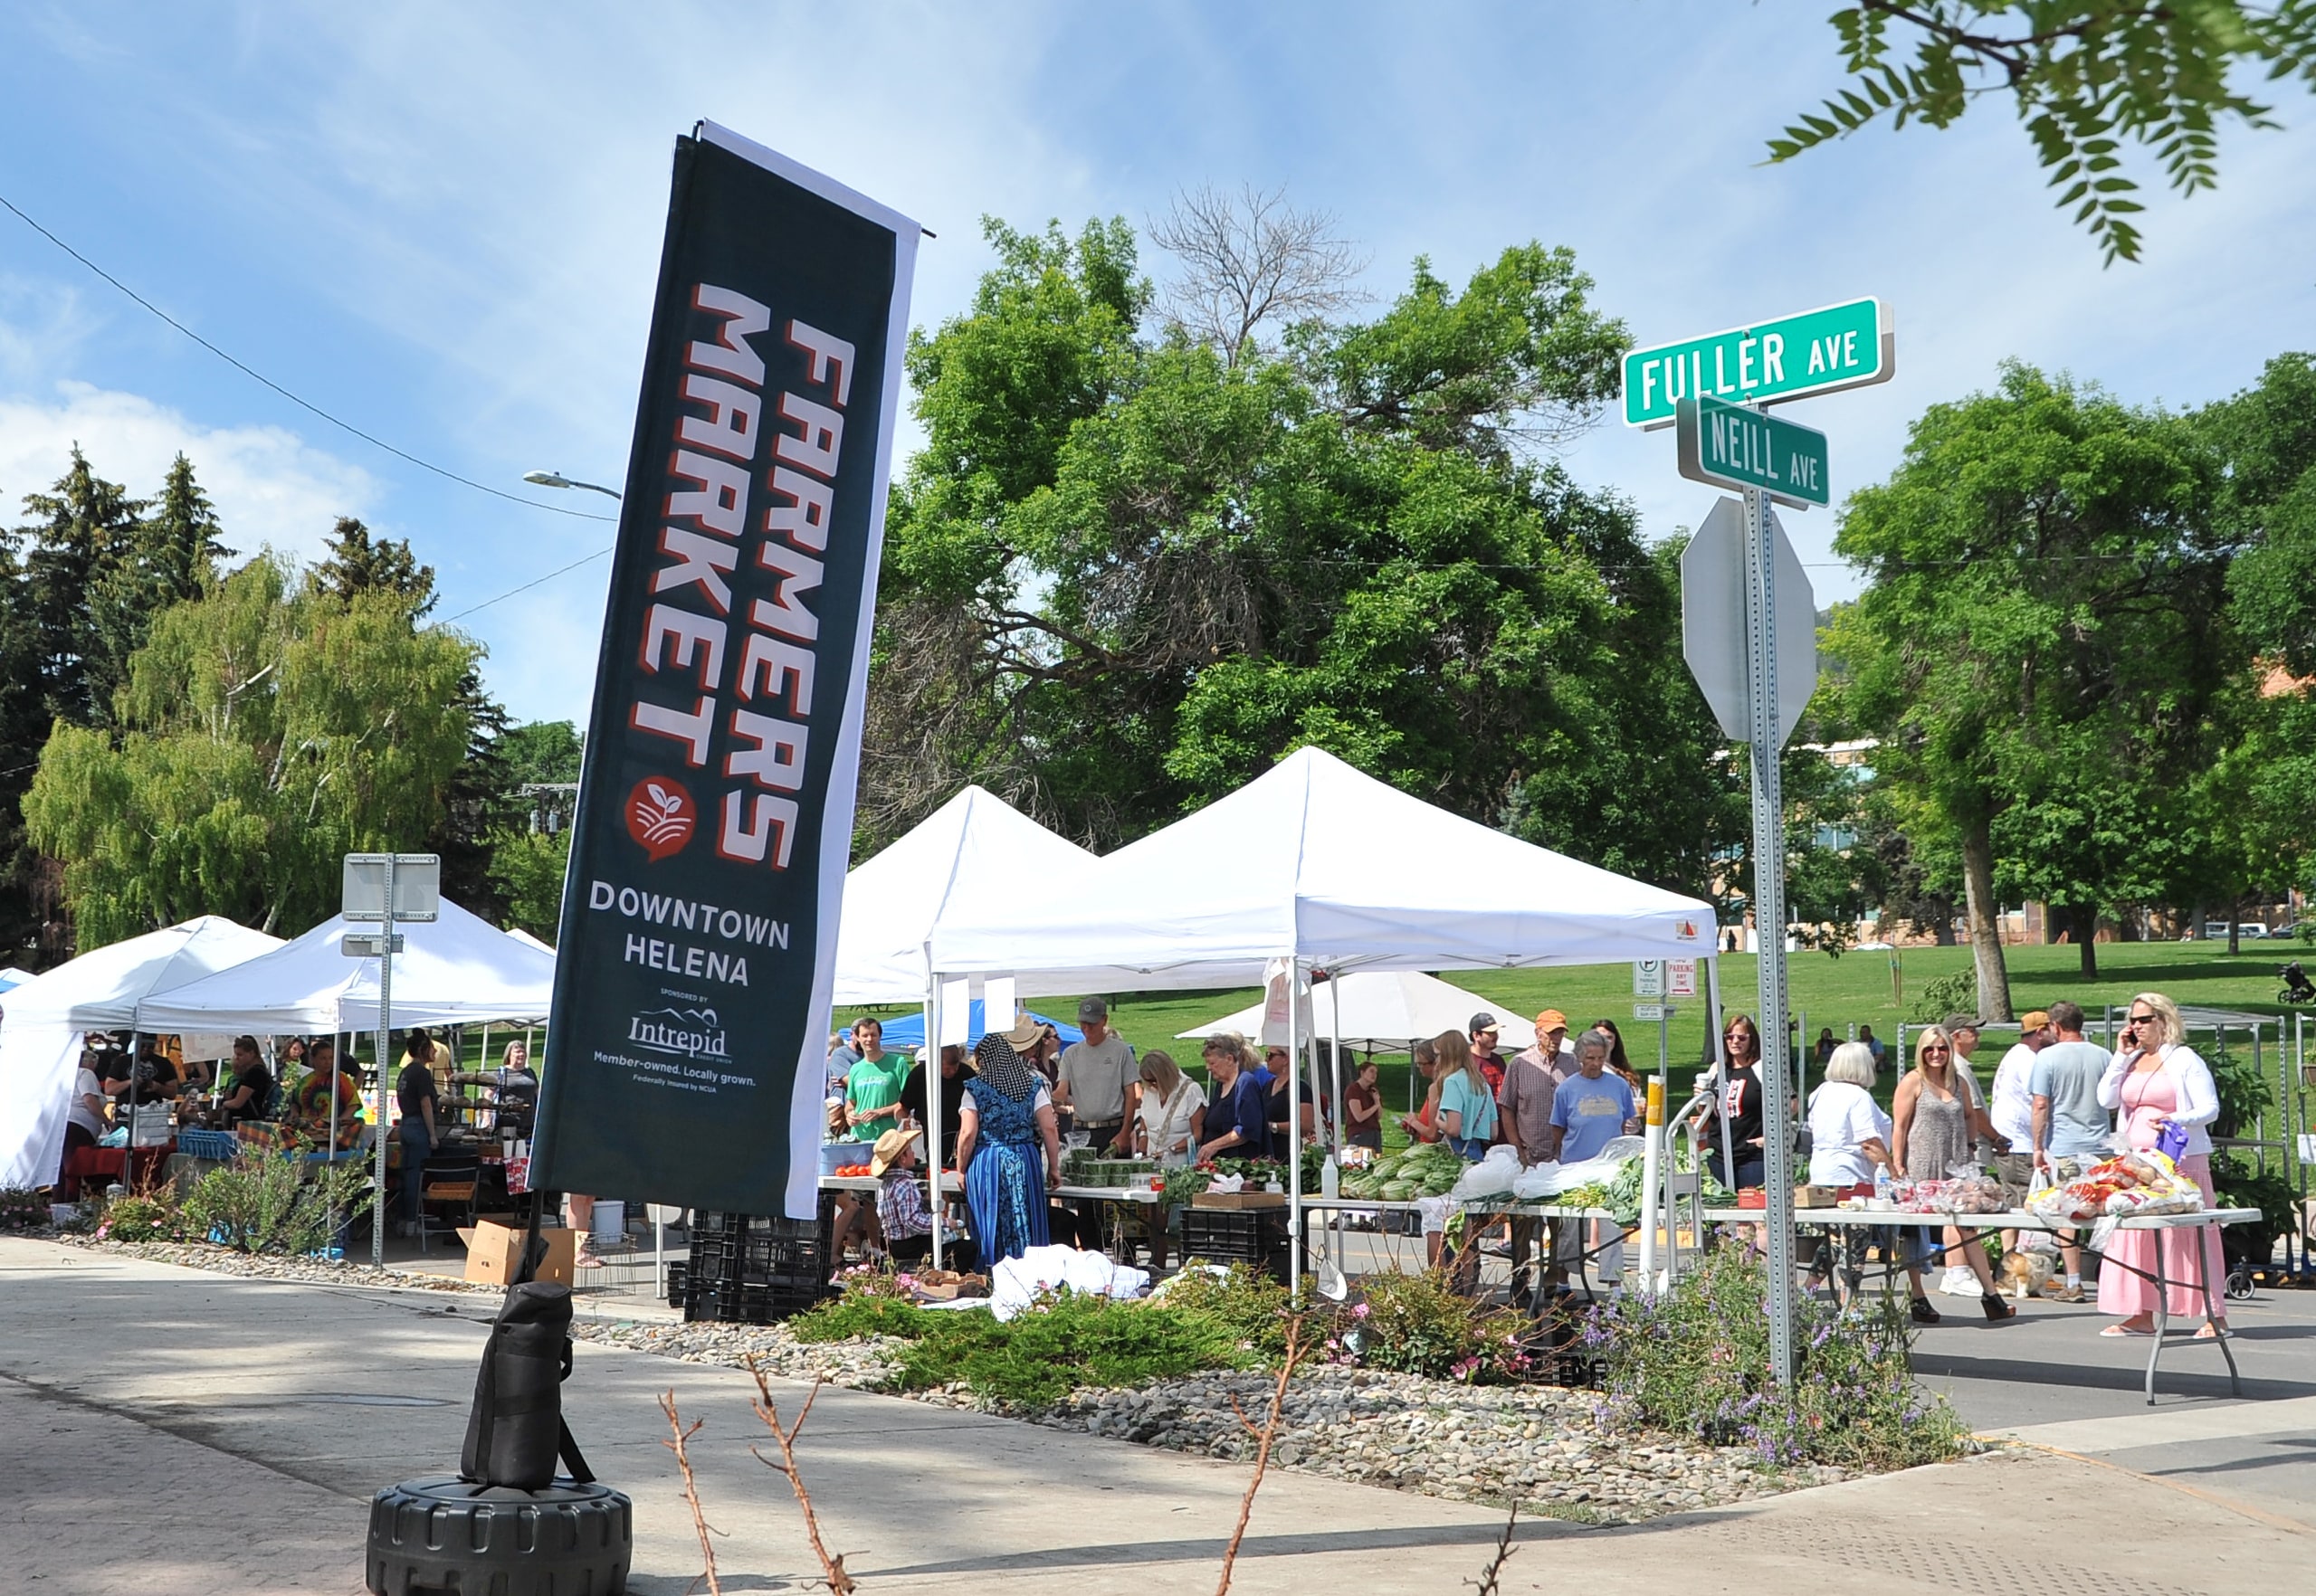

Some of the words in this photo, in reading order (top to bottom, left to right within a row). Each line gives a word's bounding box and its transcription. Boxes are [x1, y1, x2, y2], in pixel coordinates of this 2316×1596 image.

[1643, 333, 1785, 411] FULLER
[1807, 330, 1859, 375] AVE
[1711, 410, 1779, 480] NEILL
[1789, 451, 1819, 491] AVE
[631, 281, 771, 767] MARKET
[718, 318, 855, 872] FARMERS
[589, 879, 789, 950] DOWNTOWN
[624, 933, 748, 986] HELENA
[1669, 964, 1693, 973] PARKING
[661, 987, 698, 1002] SPONSORED
[699, 995, 709, 1003] BY
[627, 1016, 727, 1058] Intrepid
[594, 1050, 681, 1075] Member-owned.
[683, 1066, 719, 1082] Locally
[720, 1074, 757, 1087] grown.
[633, 1074, 666, 1087] Federally
[690, 1082, 698, 1091] by
[699, 1085, 717, 1094] NCUA
